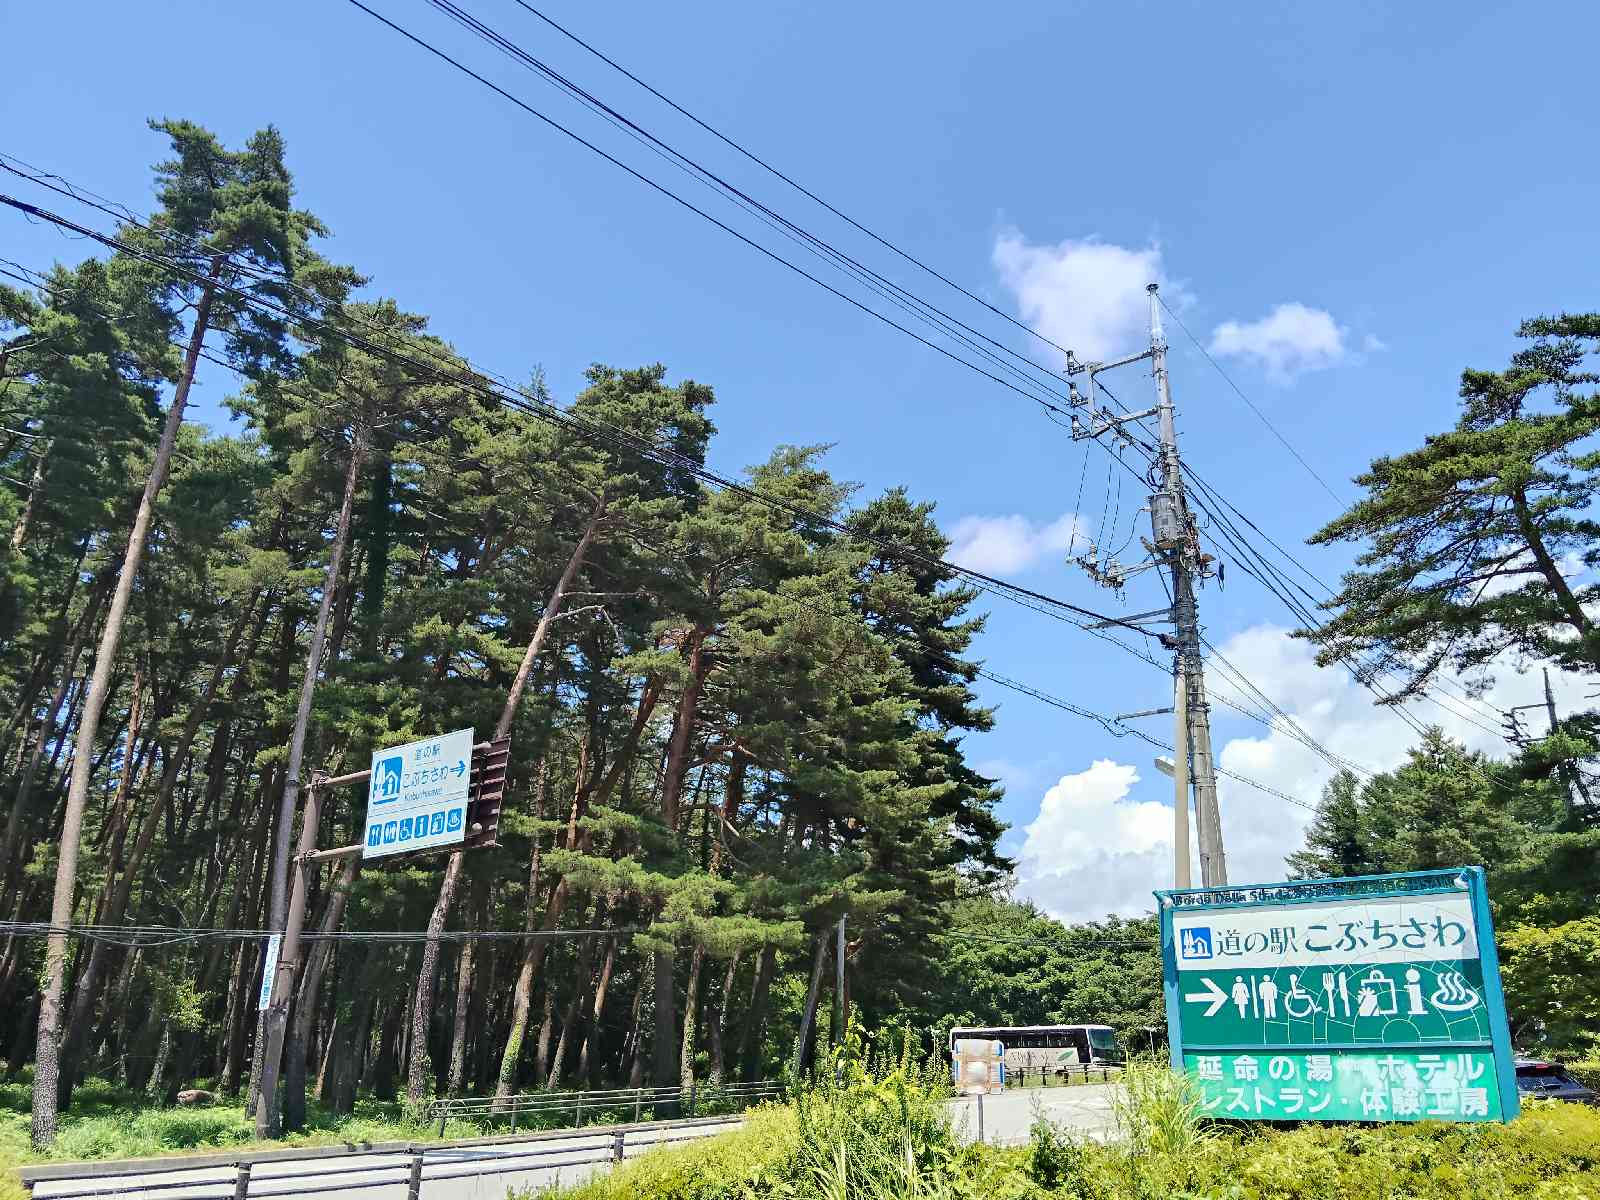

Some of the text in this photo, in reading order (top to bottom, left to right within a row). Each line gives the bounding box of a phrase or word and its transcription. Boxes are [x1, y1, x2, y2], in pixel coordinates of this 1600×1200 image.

[1215, 915, 1466, 956] 道の駅 こぶちさわ
[1196, 1053, 1485, 1081] 延命の湯 ホテル
